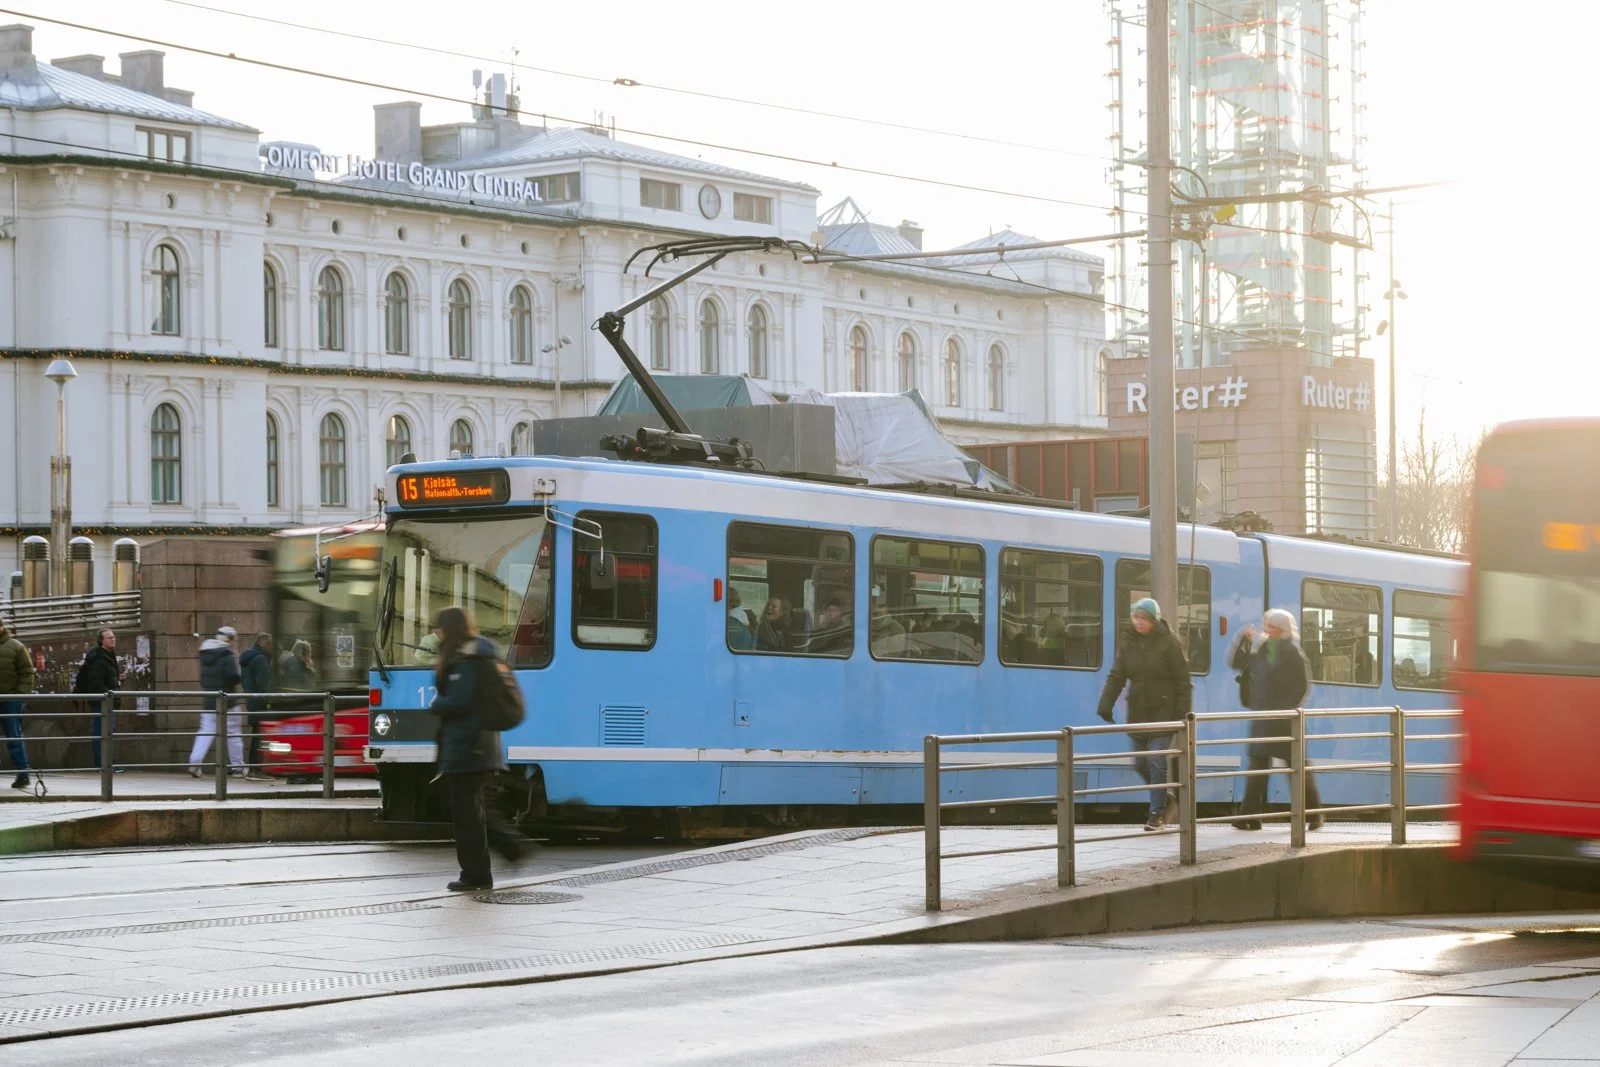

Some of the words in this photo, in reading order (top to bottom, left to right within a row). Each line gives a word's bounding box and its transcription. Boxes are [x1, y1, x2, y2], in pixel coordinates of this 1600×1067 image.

[347, 154, 404, 181] HOTEL
[408, 161, 468, 190] GRAND
[472, 172, 543, 201] CENTRAL
[1127, 375, 1248, 413] Rer#
[1302, 375, 1370, 412] Ruter#
[401, 478, 418, 500] 15
